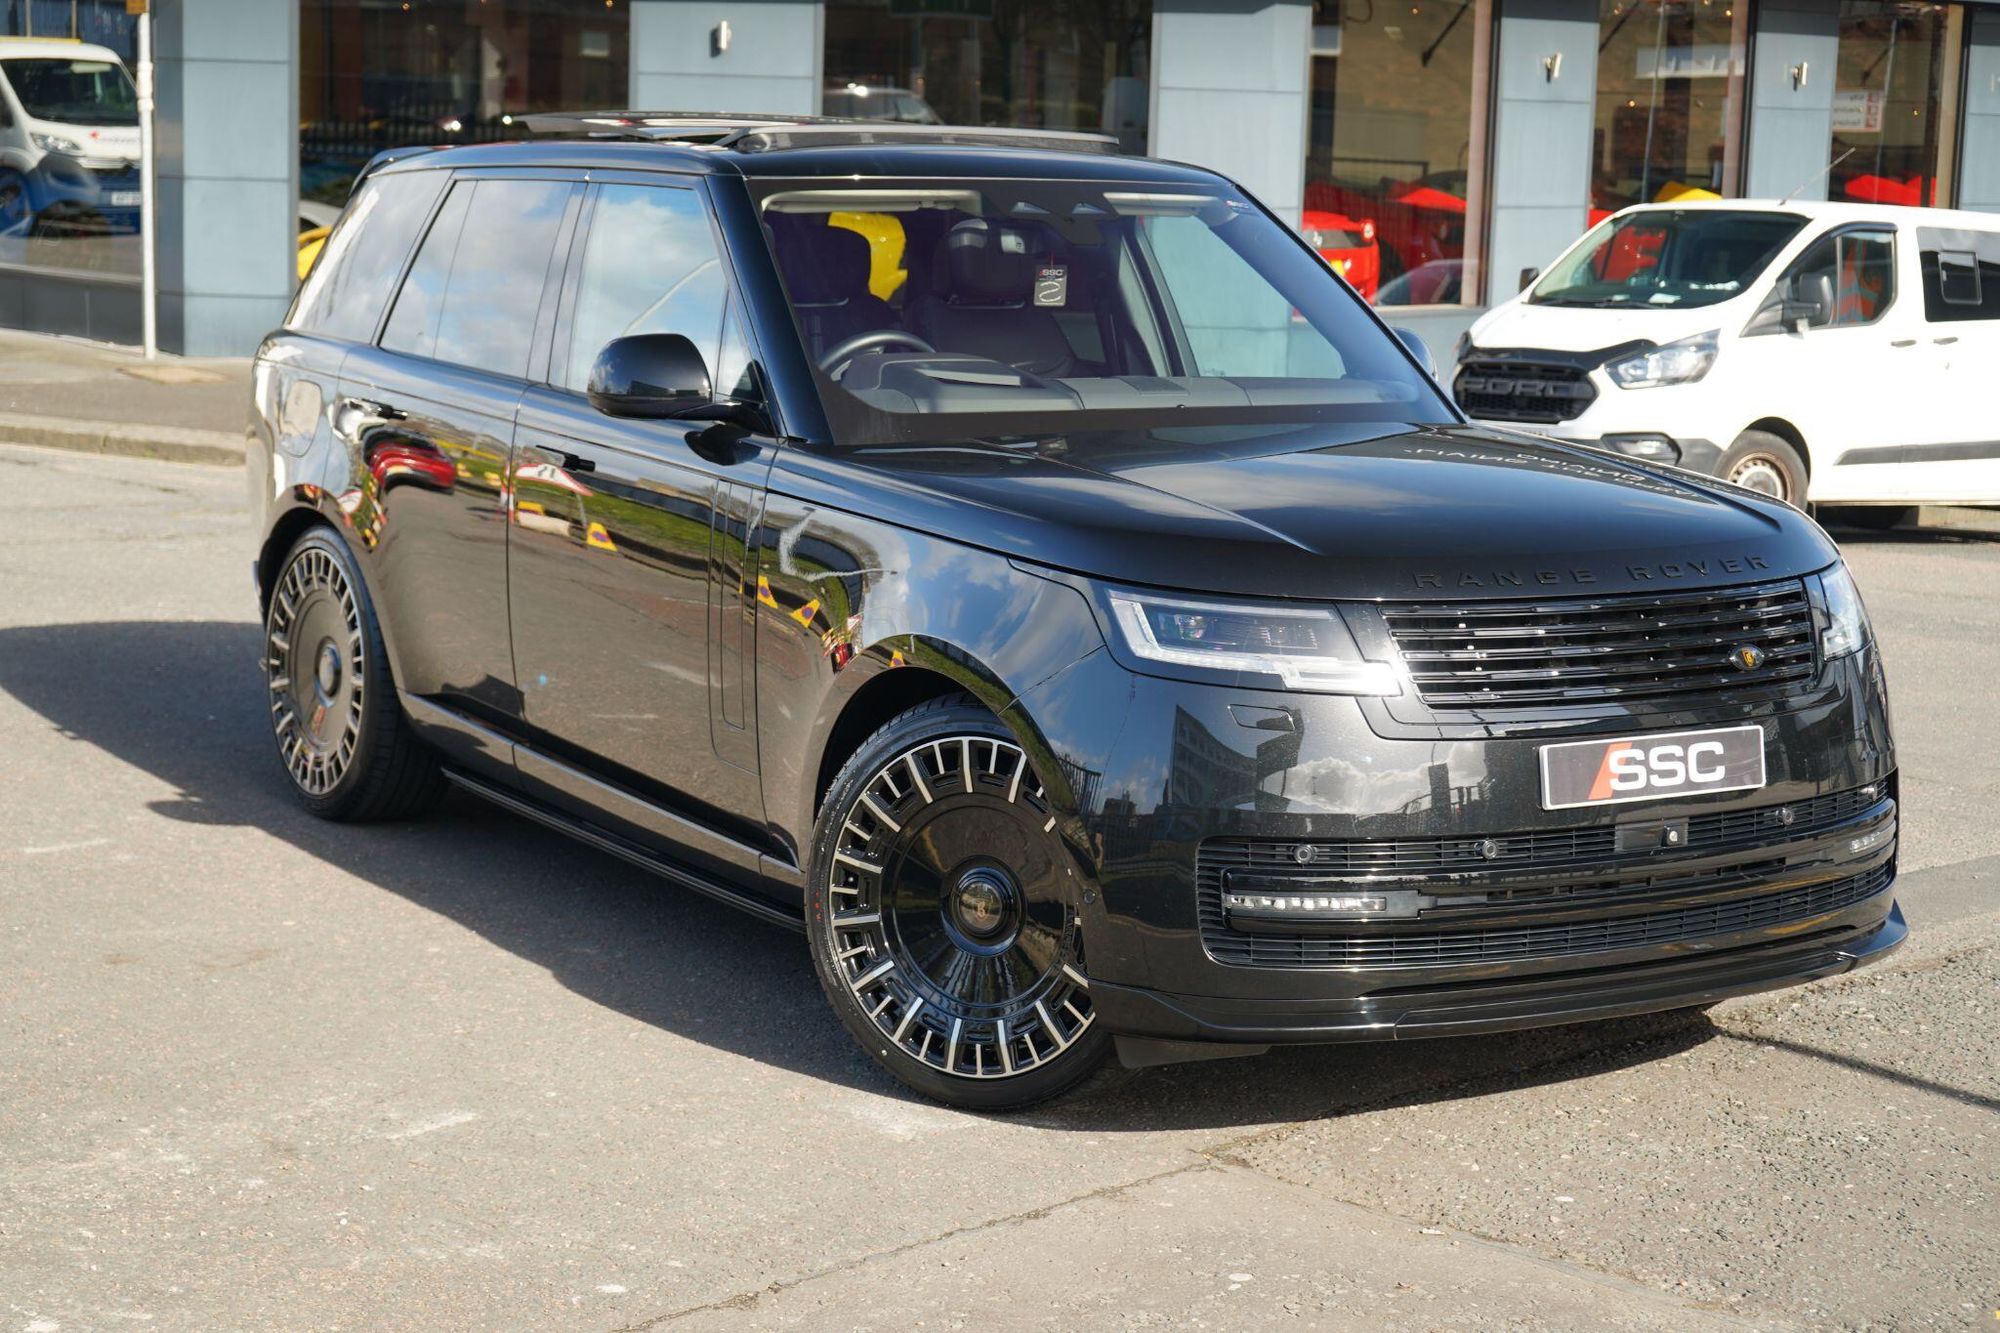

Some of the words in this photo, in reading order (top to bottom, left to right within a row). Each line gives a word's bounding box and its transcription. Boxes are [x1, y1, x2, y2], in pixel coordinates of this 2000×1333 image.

[1462, 377, 1573, 399] FORD
[1412, 569, 1598, 590] RANGE
[1625, 556, 1771, 580] ROVER
[1608, 741, 1726, 791] SSC
